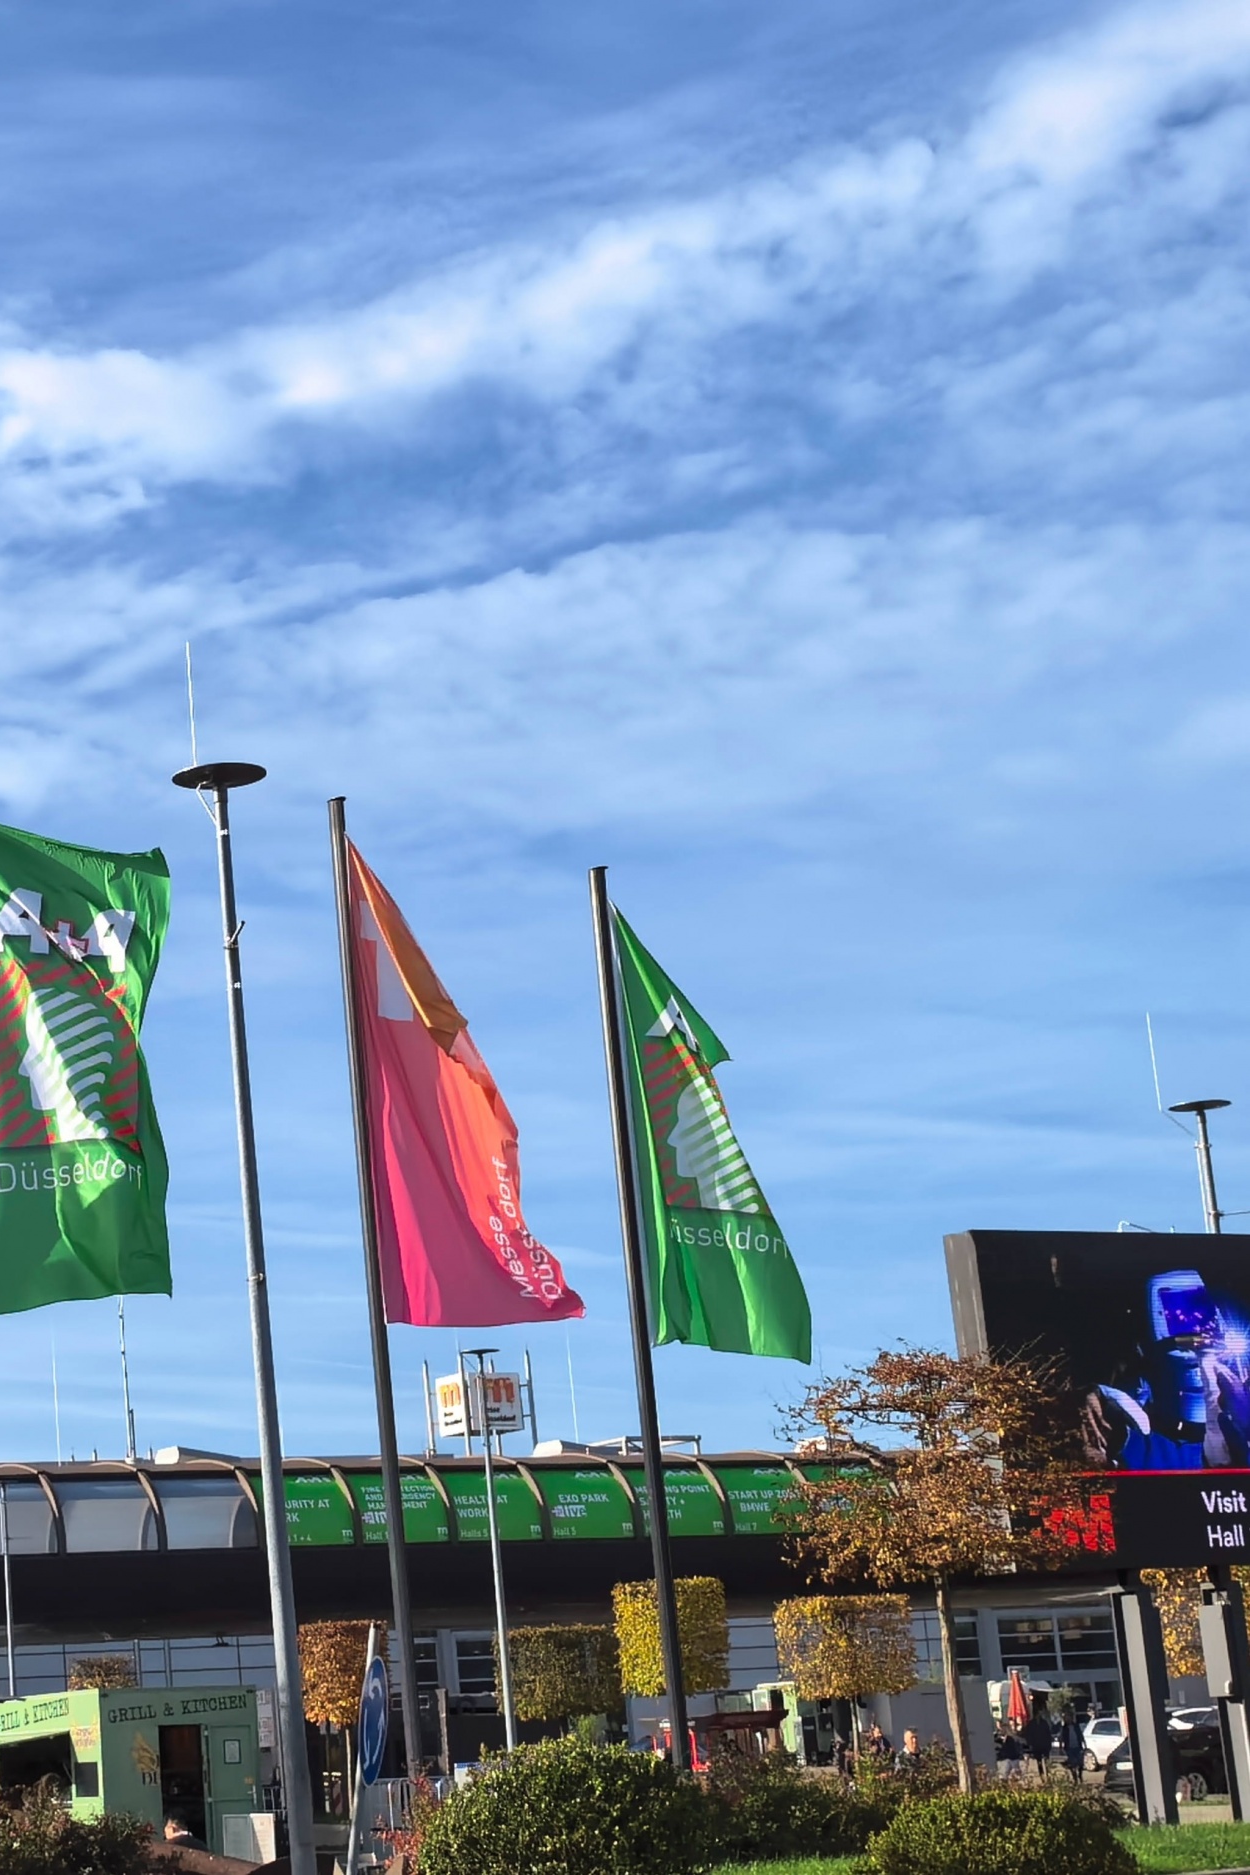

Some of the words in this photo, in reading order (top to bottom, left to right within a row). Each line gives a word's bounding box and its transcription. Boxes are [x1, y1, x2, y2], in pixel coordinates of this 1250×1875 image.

[489, 1215, 541, 1298] Messe
[680, 1484, 710, 1492] POINT
[558, 1494, 579, 1502] EXO
[581, 1493, 609, 1502] PARK
[728, 1490, 758, 1499] START
[760, 1490, 774, 1499] UP
[285, 1499, 313, 1509] URITY
[318, 1499, 330, 1508] AT
[453, 1495, 488, 1505] HEALT
[496, 1495, 508, 1504] AT
[1201, 1490, 1247, 1513] Visit
[285, 1512, 300, 1522] RK
[457, 1508, 488, 1517] WORK
[1207, 1525, 1245, 1547] Hall
[32, 1698, 70, 1723] KITCHEN
[108, 1704, 156, 1723] GRILL
[163, 1703, 174, 1716] &
[181, 1694, 247, 1714] KITCHEN
